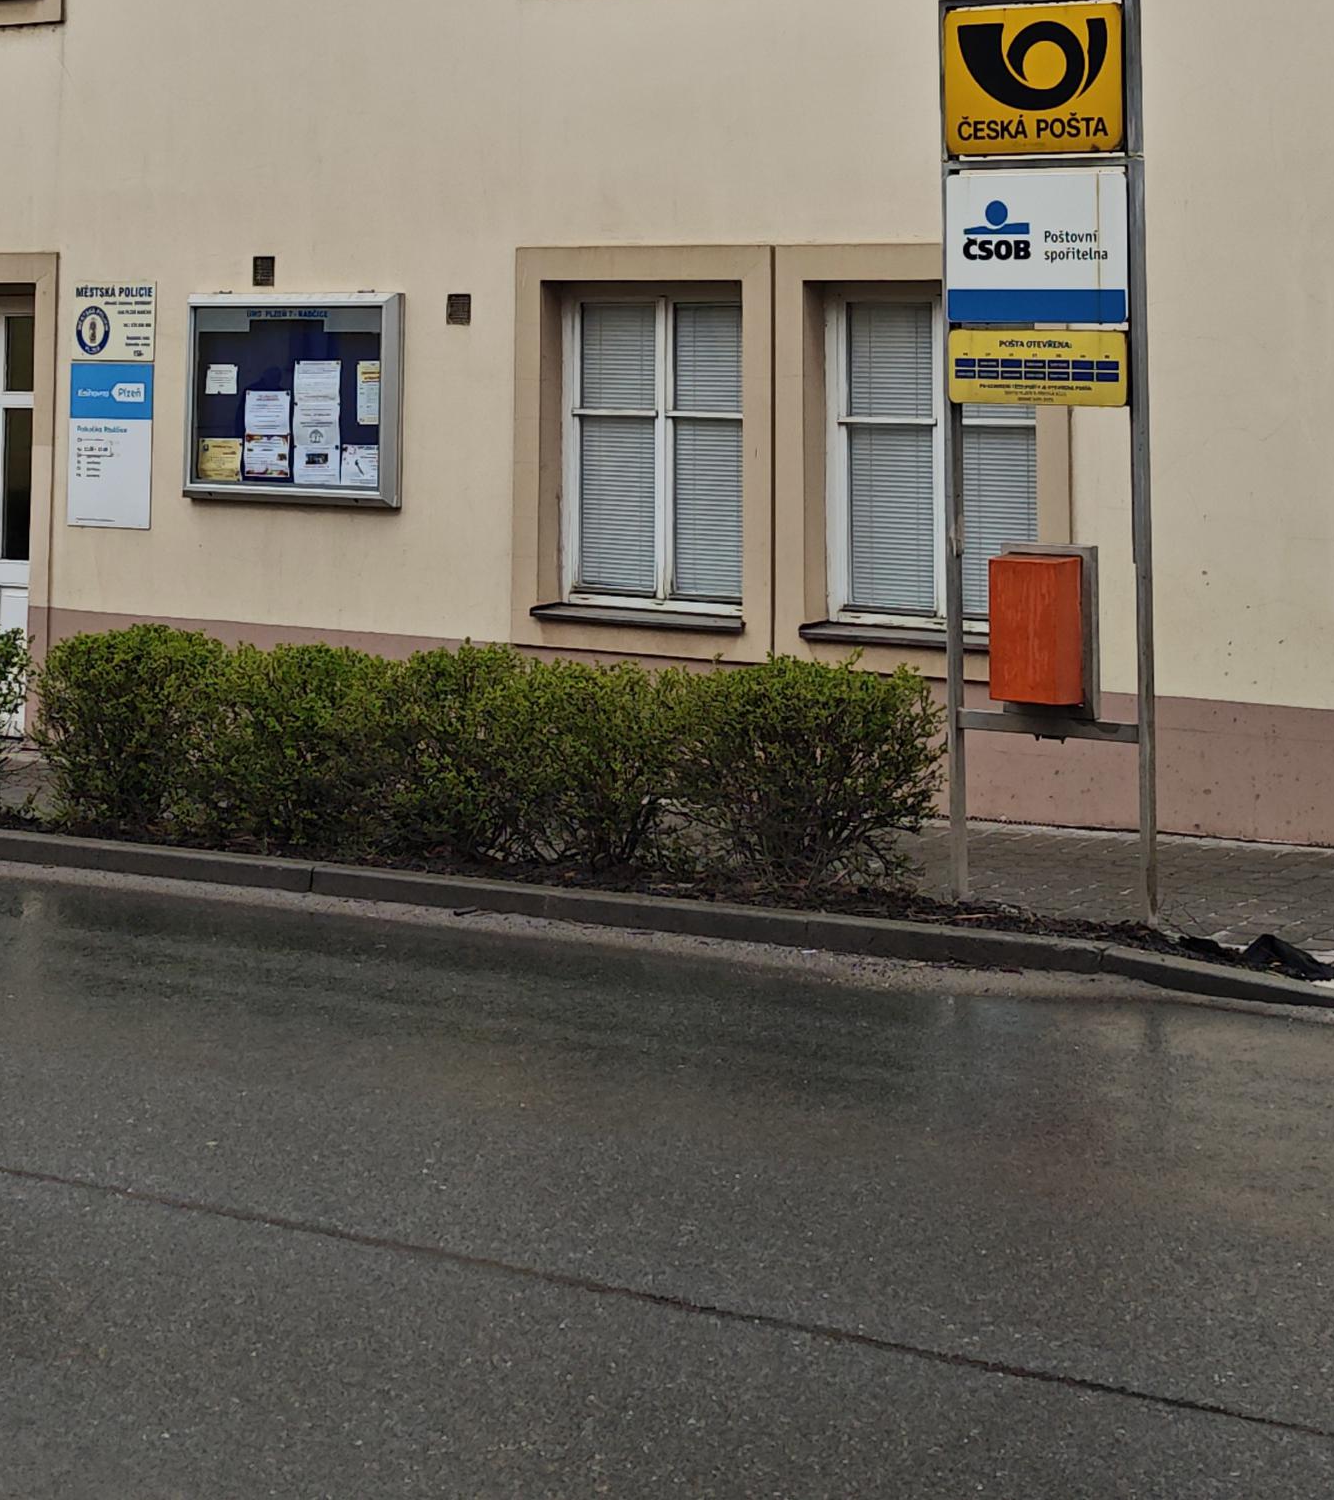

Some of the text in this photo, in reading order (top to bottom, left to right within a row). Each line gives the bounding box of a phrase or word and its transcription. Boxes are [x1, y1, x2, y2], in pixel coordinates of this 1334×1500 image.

[957, 112, 1108, 141] ČESKÁ POŠTA
[1044, 230, 1098, 243] Poštovní
[963, 237, 1031, 261] ČSOB
[1044, 248, 1108, 263] spořitelna
[75, 284, 153, 298] MĚSTSKÁ POLICIE
[999, 339, 1024, 348] POŠTA
[118, 387, 142, 398] Plzeň
